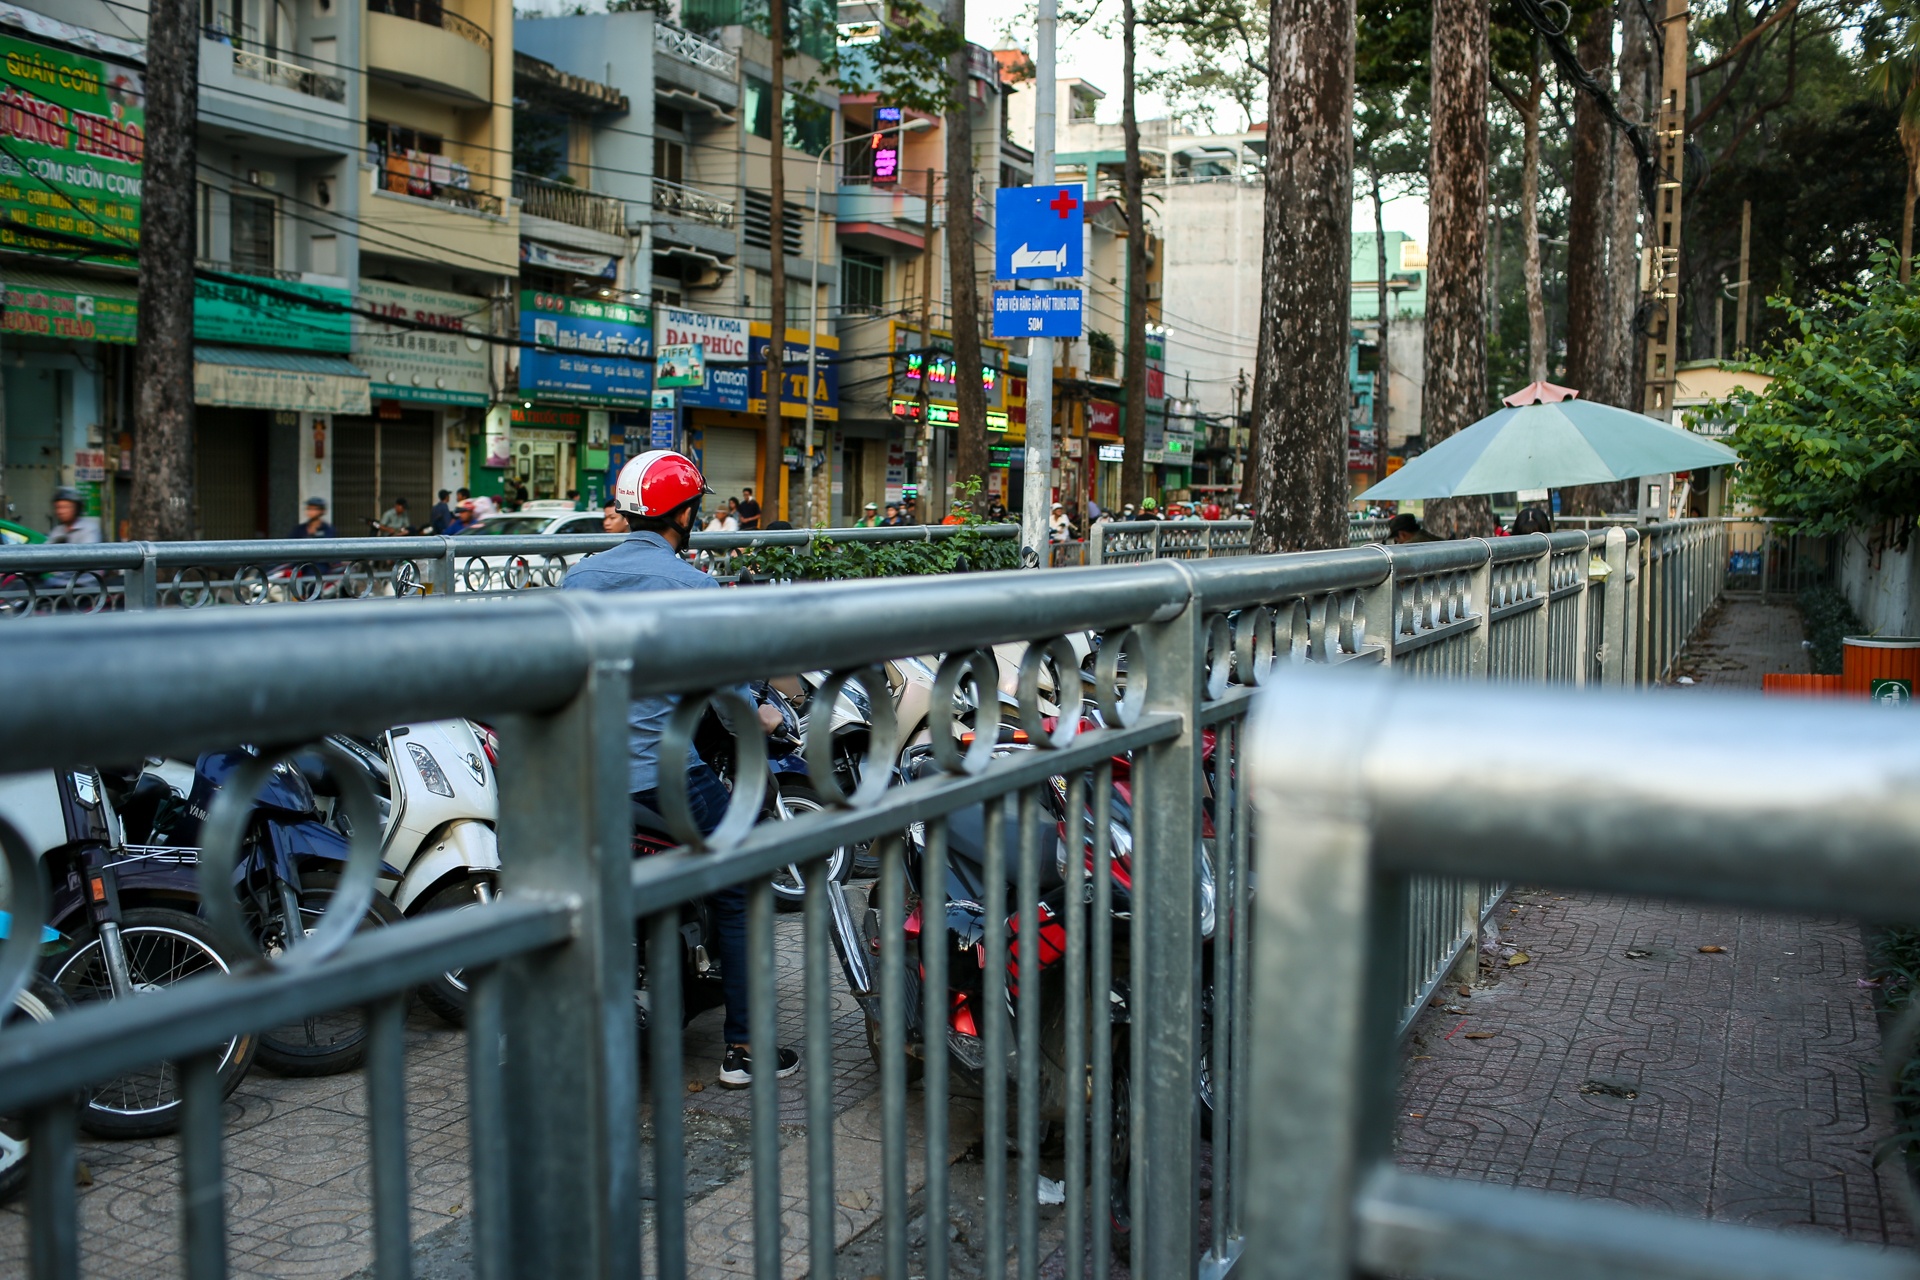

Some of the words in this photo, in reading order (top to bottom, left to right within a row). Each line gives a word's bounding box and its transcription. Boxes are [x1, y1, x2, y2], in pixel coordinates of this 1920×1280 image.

[6, 51, 55, 85] QUÁN
[59, 65, 98, 95] CƠM
[27, 156, 63, 181] CƠM
[1051, 296, 1067, 311] TRUNG
[669, 309, 694, 328] DỤNG
[696, 313, 709, 332] CỤ
[711, 316, 717, 329] Y
[718, 320, 741, 334] KHOA
[1027, 317, 1043, 332] 50M
[662, 347, 693, 359] TIFFY
[703, 333, 744, 357] PHÚC
